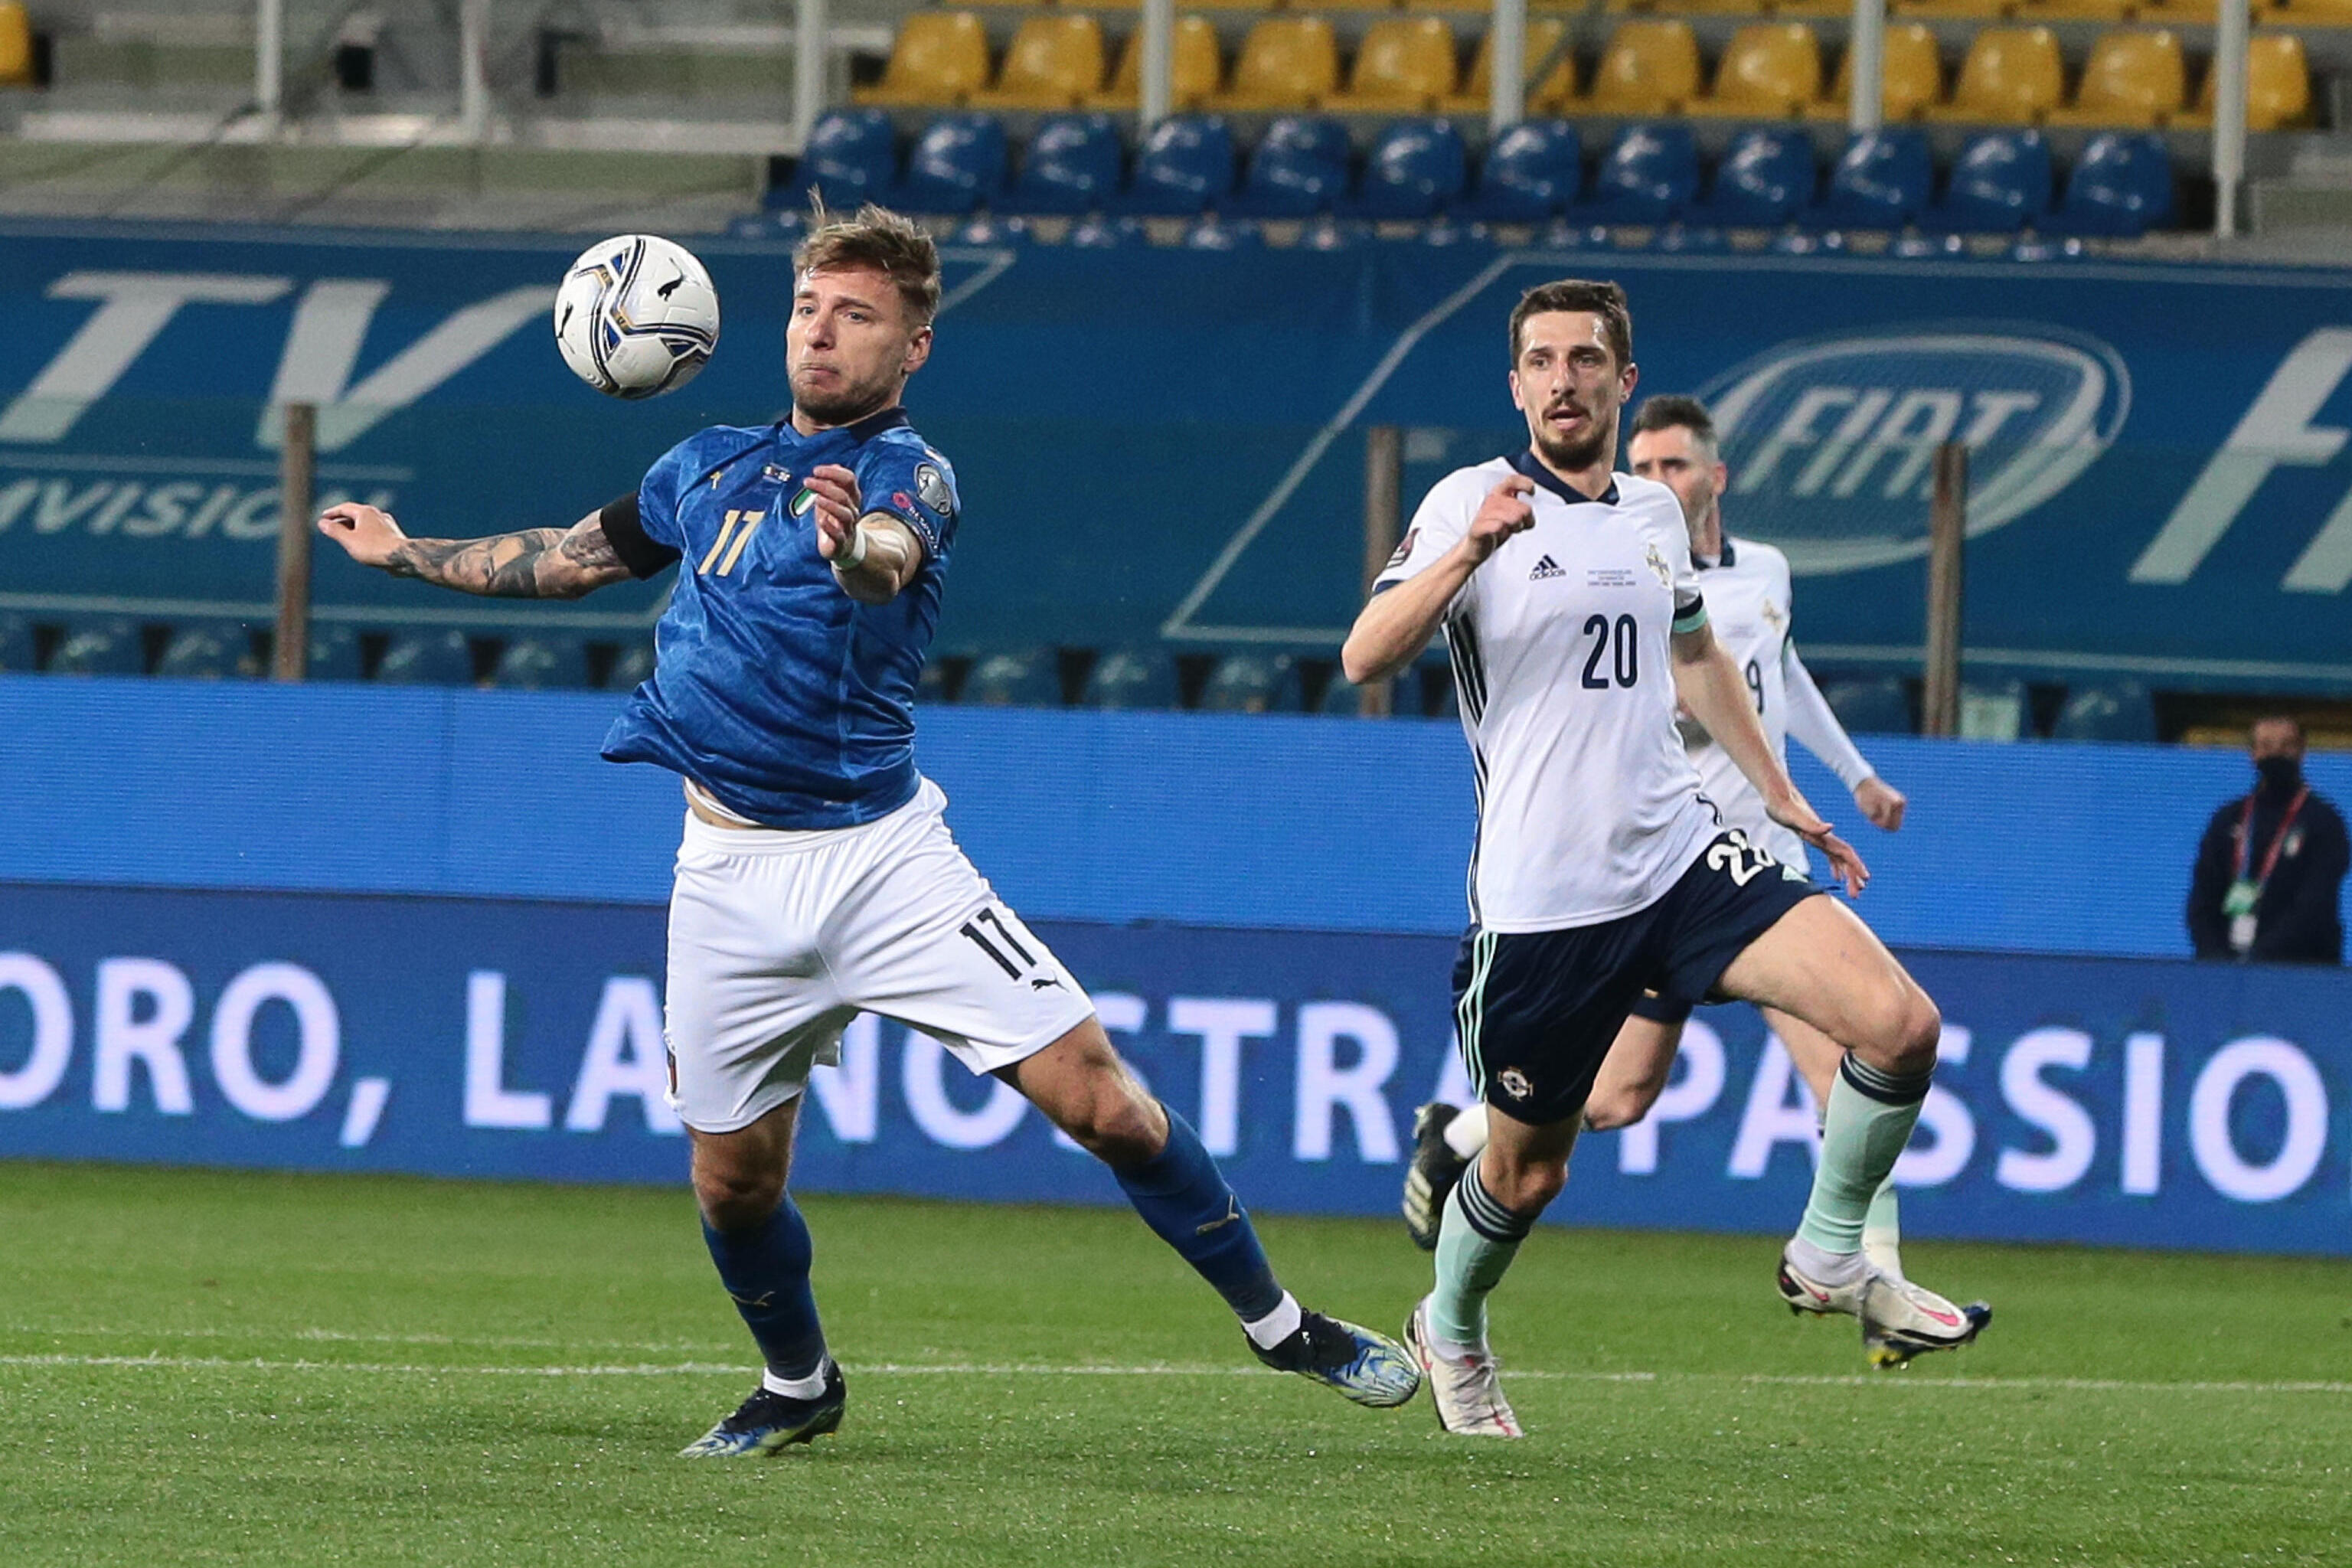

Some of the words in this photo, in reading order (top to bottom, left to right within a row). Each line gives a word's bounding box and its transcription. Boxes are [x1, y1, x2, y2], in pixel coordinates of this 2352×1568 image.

[0, 270, 563, 453] TV
[1733, 387, 2043, 502] FIAT
[0, 479, 394, 540] VISIO
[697, 509, 765, 577] 17
[1582, 613, 1638, 689] 20
[959, 907, 1037, 982] 17
[464, 970, 688, 1134] LA
[808, 991, 1484, 1164] NOTR
